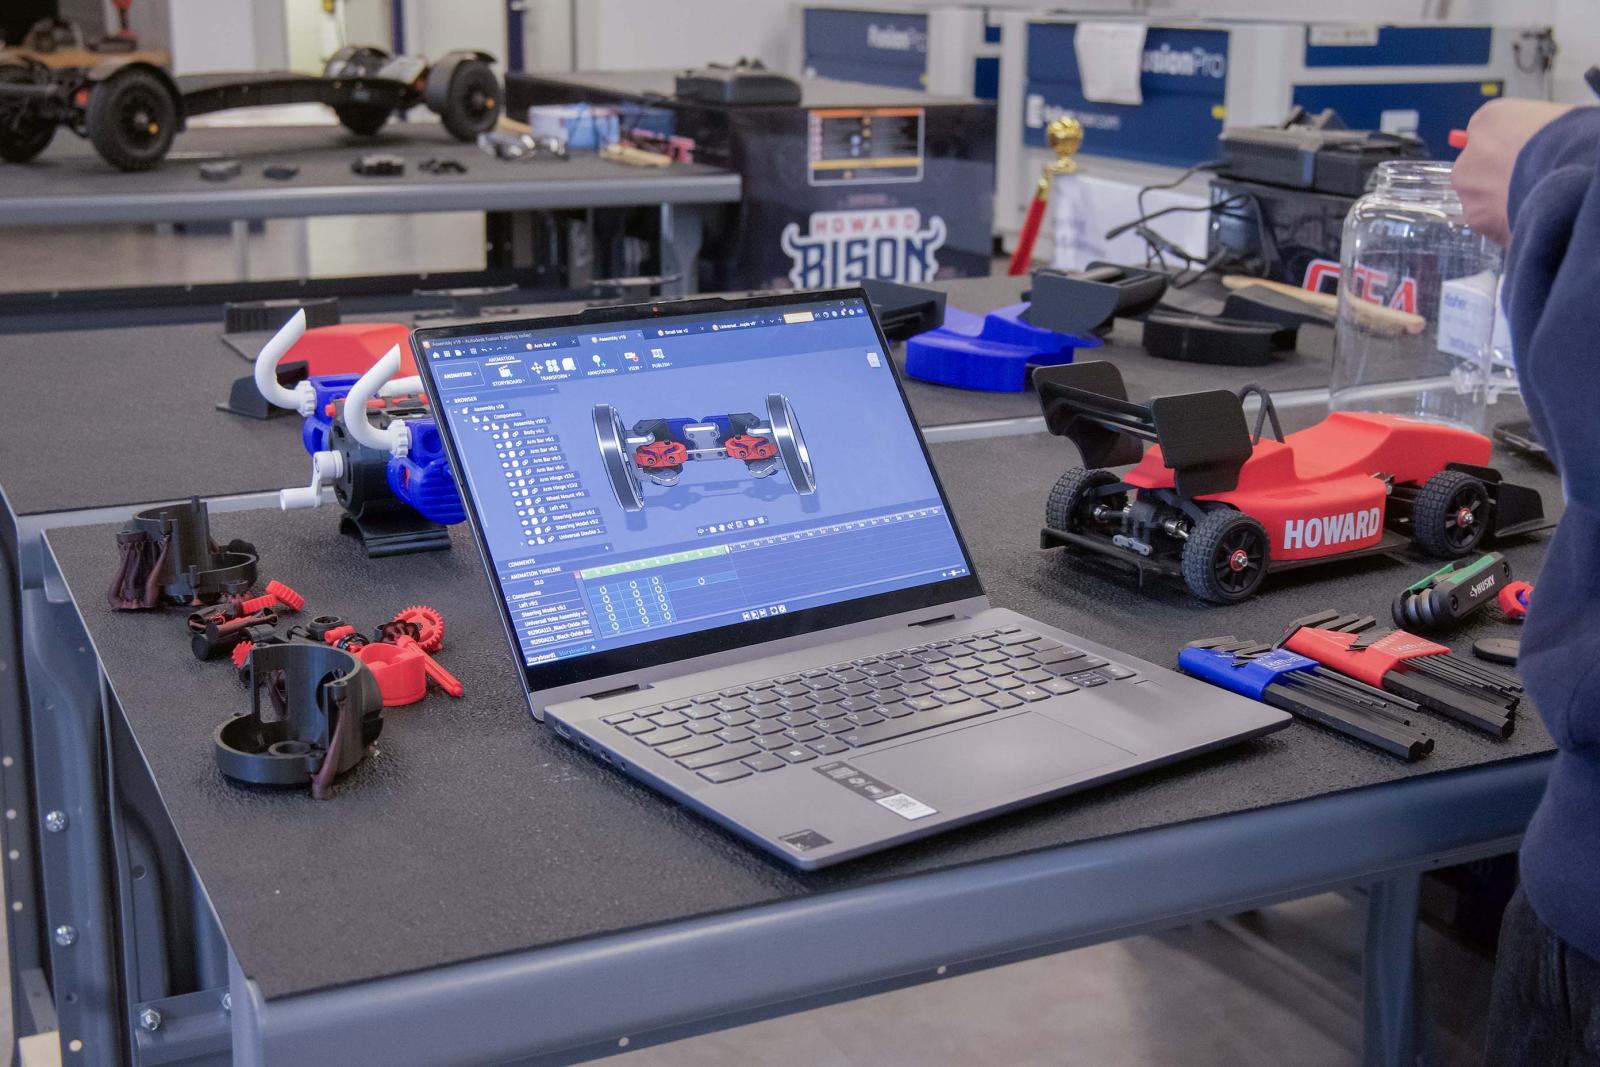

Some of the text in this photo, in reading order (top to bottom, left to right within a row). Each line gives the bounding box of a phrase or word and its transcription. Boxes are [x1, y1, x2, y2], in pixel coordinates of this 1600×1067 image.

[815, 213, 915, 233] HOWARD
[797, 236, 932, 288] BISON
[443, 371, 472, 379] ANIMATION
[540, 373, 568, 381] TRANSFORM
[493, 411, 522, 419] Components
[552, 513, 572, 521] Steering
[555, 522, 575, 530] Steering
[1283, 507, 1381, 550] HOWARD
[558, 532, 580, 540] Universal
[508, 558, 535, 568] COMMENTS
[510, 566, 561, 579] ANIMATION TIMELINE
[1476, 574, 1495, 595] HUSKY
